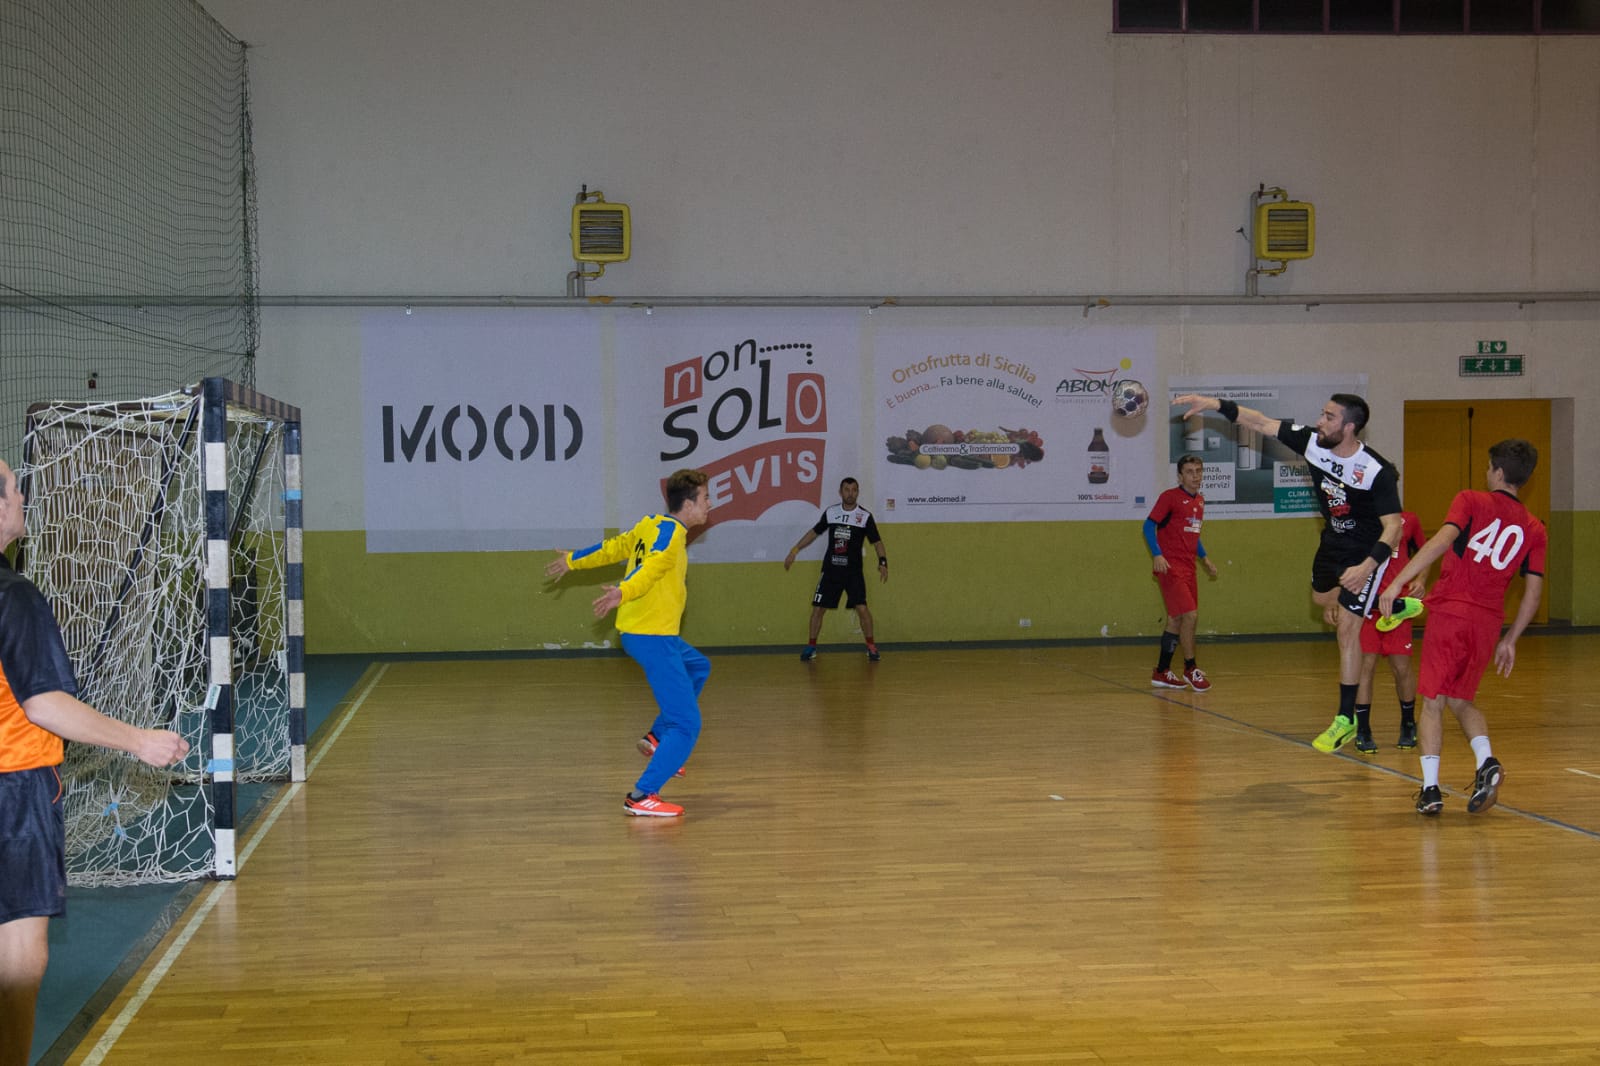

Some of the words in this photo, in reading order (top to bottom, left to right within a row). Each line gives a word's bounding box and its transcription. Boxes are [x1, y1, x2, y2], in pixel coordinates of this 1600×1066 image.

[668, 338, 757, 400] non
[891, 353, 971, 384] Ortofrutta
[975, 351, 991, 367] di
[993, 355, 1038, 385] Sicilia
[940, 376, 953, 387] Fa
[956, 375, 984, 386] bene
[986, 377, 1005, 391] alla
[1006, 384, 1043, 409] salute!
[382, 403, 584, 463] MOOD
[660, 359, 824, 462] SOLO
[710, 448, 819, 508] EVI'S
[907, 495, 967, 503] www.abiomed.it
[1205, 480, 1230, 489] servizi
[1467, 517, 1525, 570] 40
